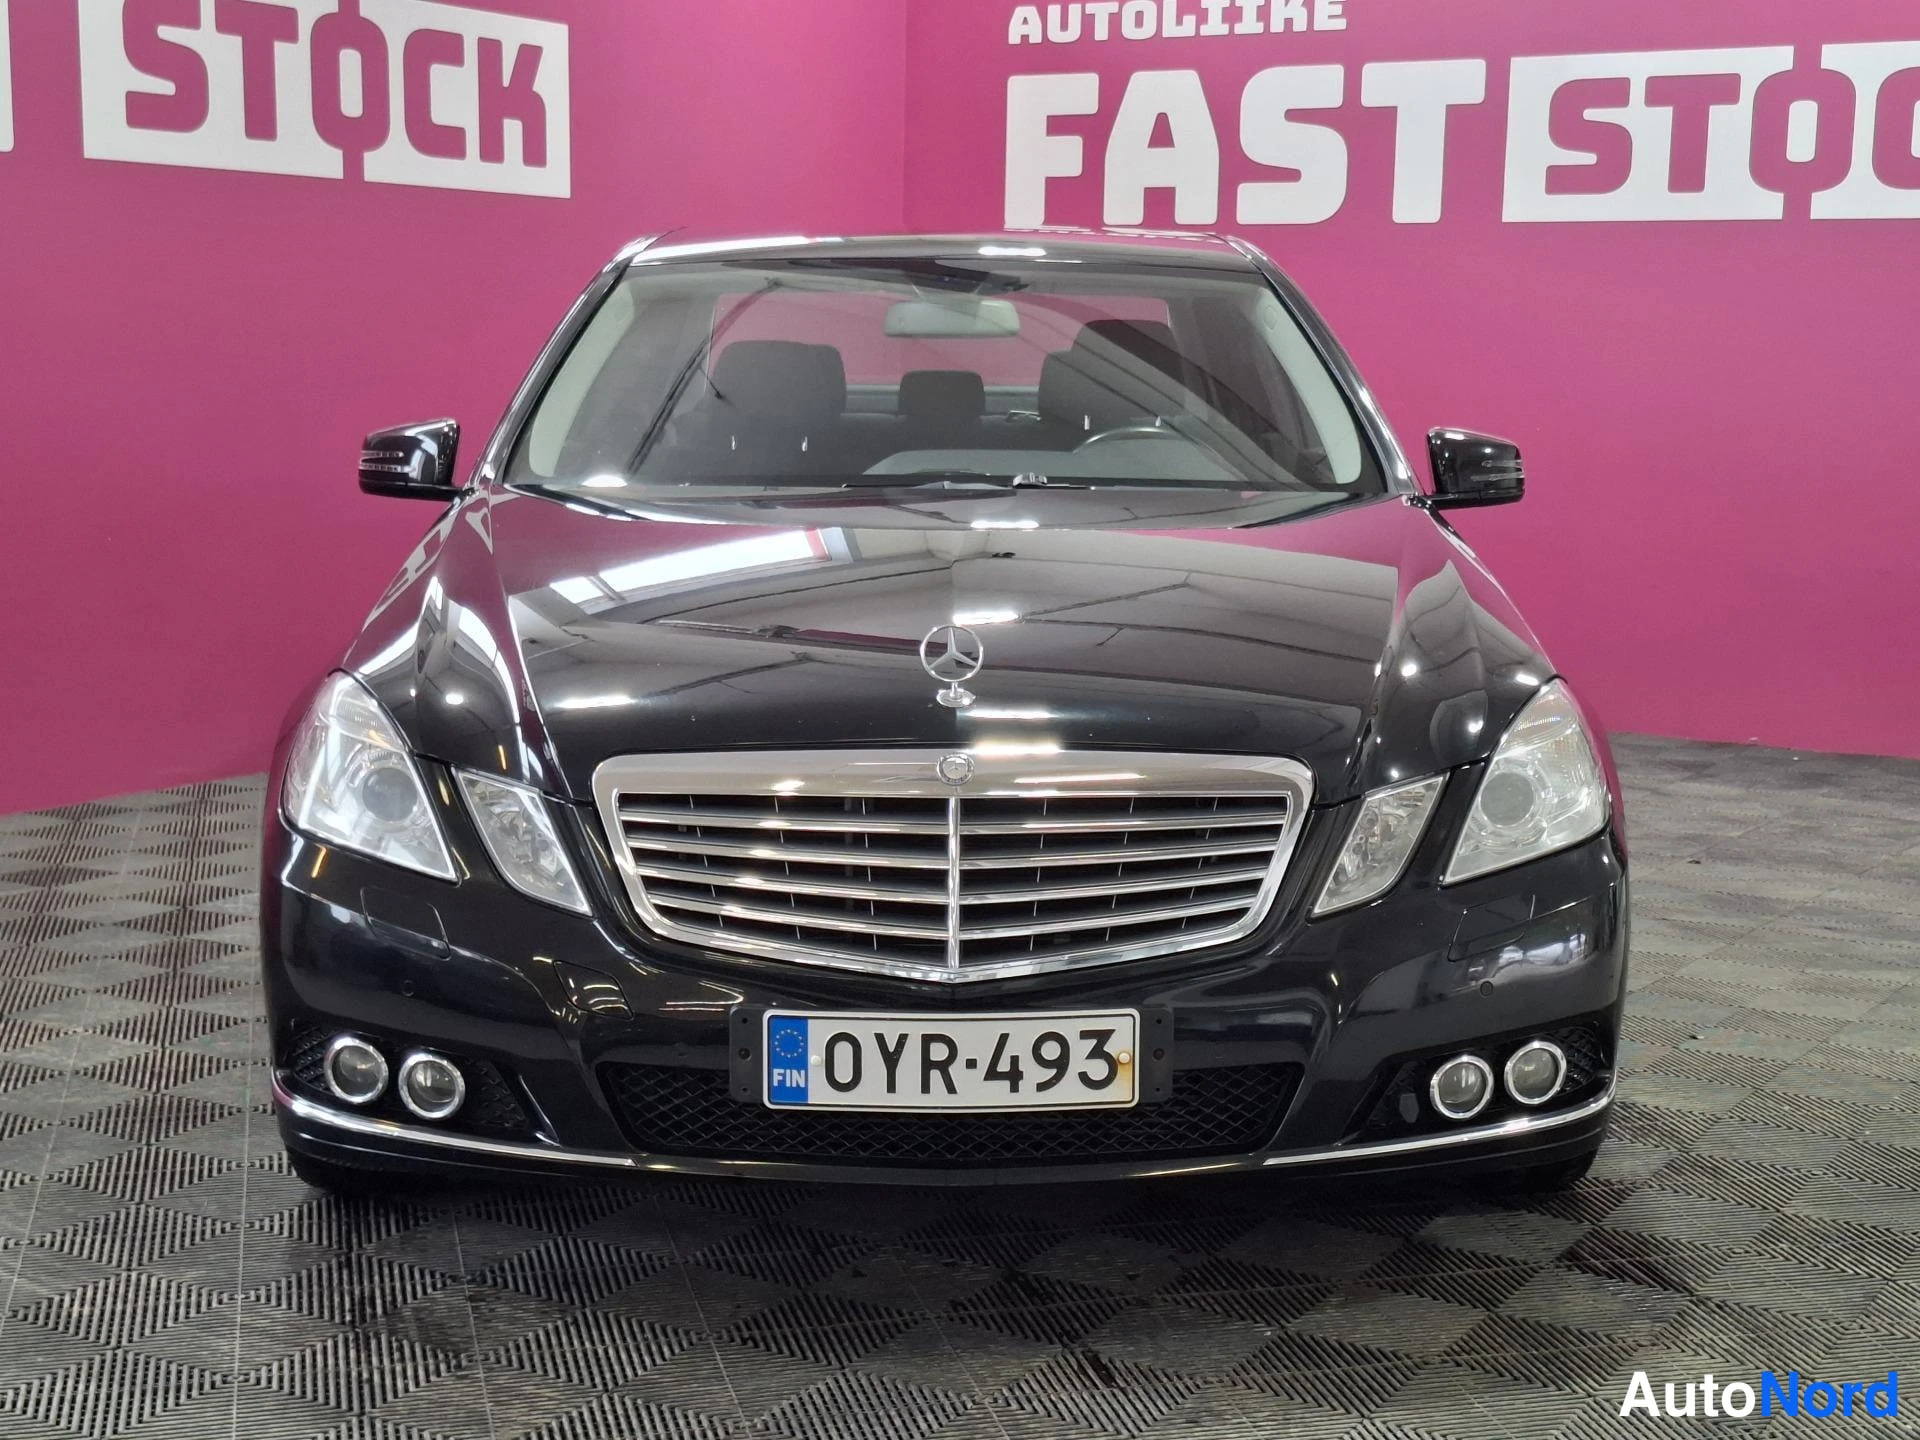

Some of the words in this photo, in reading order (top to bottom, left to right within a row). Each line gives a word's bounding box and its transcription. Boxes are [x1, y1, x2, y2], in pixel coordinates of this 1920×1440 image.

[1008, 0, 1347, 44] AUTOLIIKE
[121, 0, 548, 168] STOCK
[1004, 58, 1487, 226] FAST
[773, 1068, 806, 1089] FIN
[824, 1029, 1119, 1095] OYR-493
